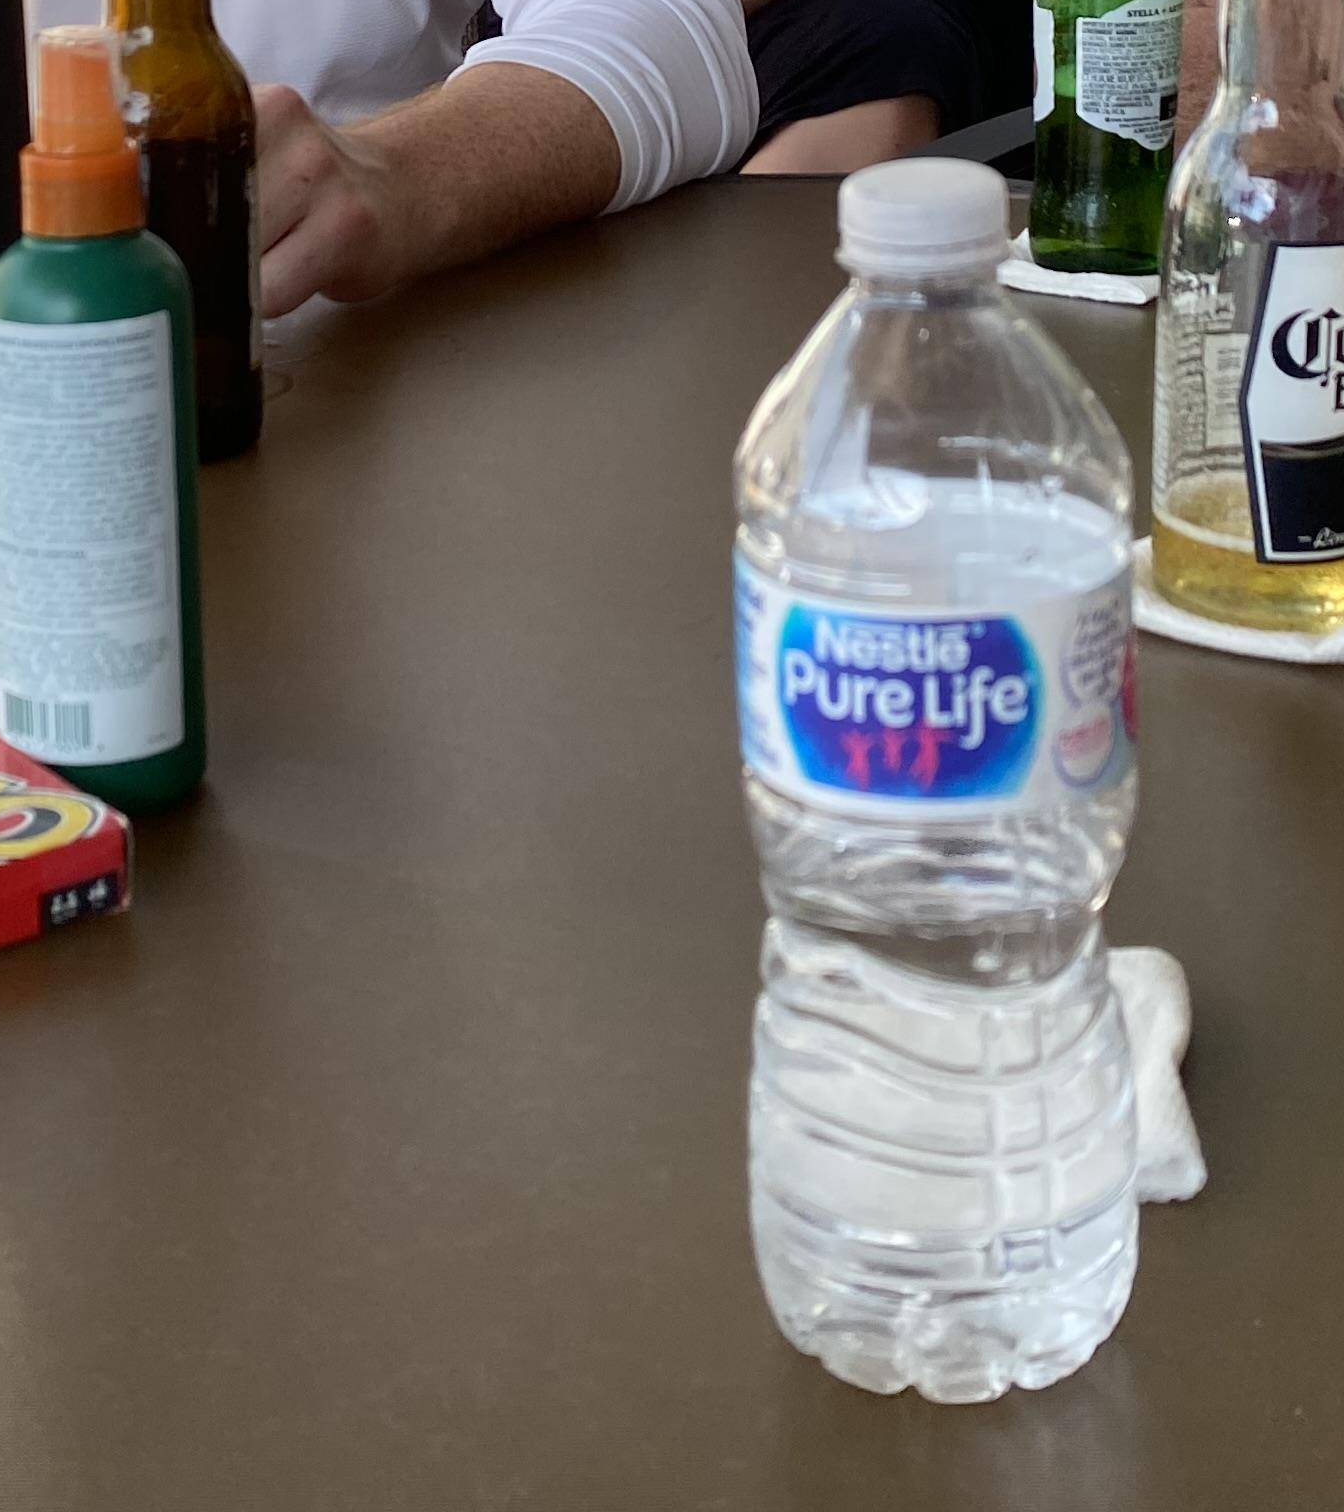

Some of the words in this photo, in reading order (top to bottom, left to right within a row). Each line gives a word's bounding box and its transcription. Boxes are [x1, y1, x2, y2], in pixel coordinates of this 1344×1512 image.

[1127, 8, 1160, 17] STELLA
[783, 647, 915, 728] Pure
[922, 664, 1029, 750] Life
